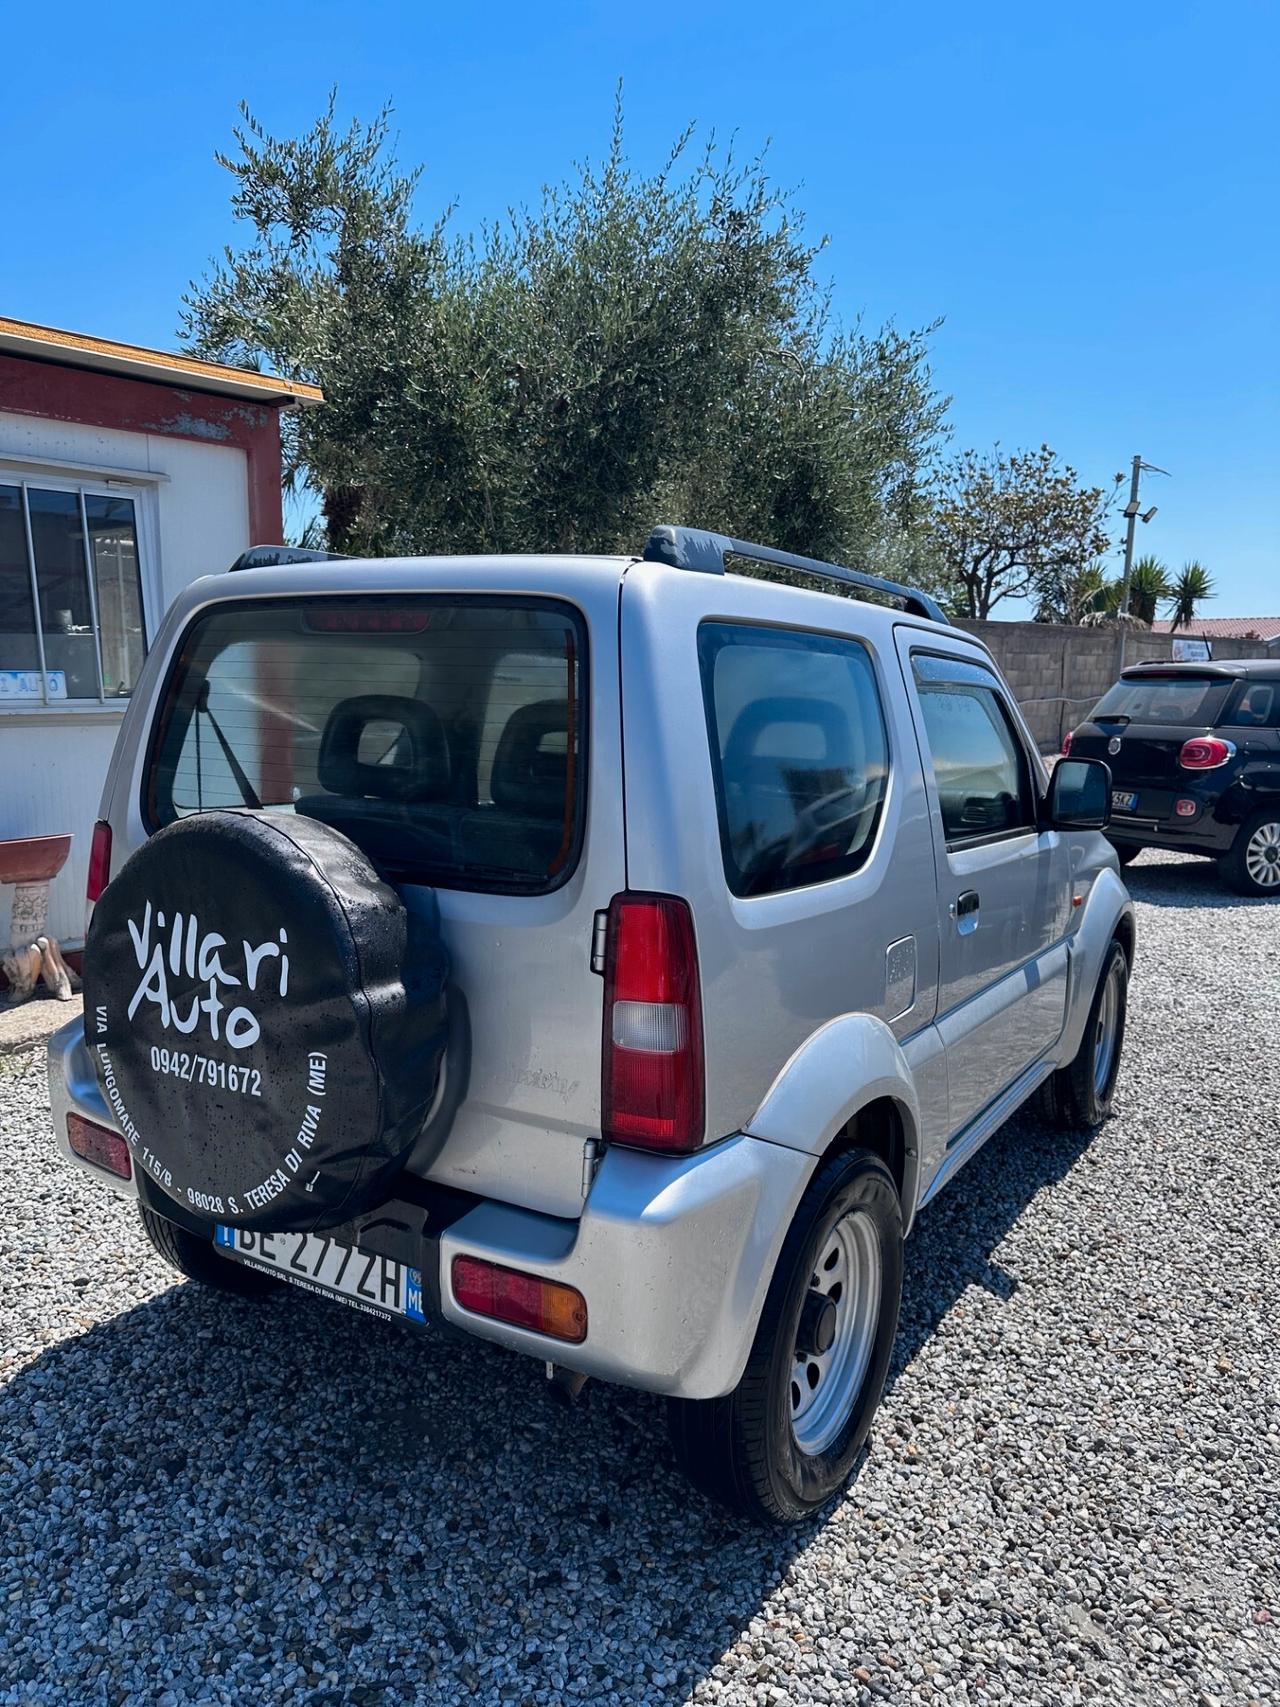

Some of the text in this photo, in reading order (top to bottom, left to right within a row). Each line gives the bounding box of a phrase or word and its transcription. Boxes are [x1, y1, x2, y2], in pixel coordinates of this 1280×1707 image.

[127, 899, 289, 997] Villari
[127, 943, 261, 1049] Auto
[95, 1005, 108, 1034] VIA
[150, 1046, 262, 1097] 0942/791672
[307, 1051, 328, 1096] (ME)
[96, 1042, 141, 1147] LUNGOMARE
[297, 1104, 322, 1150] RIVA
[142, 1147, 173, 1189] 115/B
[284, 1147, 303, 1174] DI
[187, 1187, 225, 1214] 98028
[227, 1196, 244, 1215] S.
[243, 1168, 291, 1210] TERESA
[290, 1232, 401, 1309] 277ZH
[314, 1286, 322, 1295] DI
[321, 1289, 335, 1300] RIVA
[334, 1294, 348, 1305] (ME)
